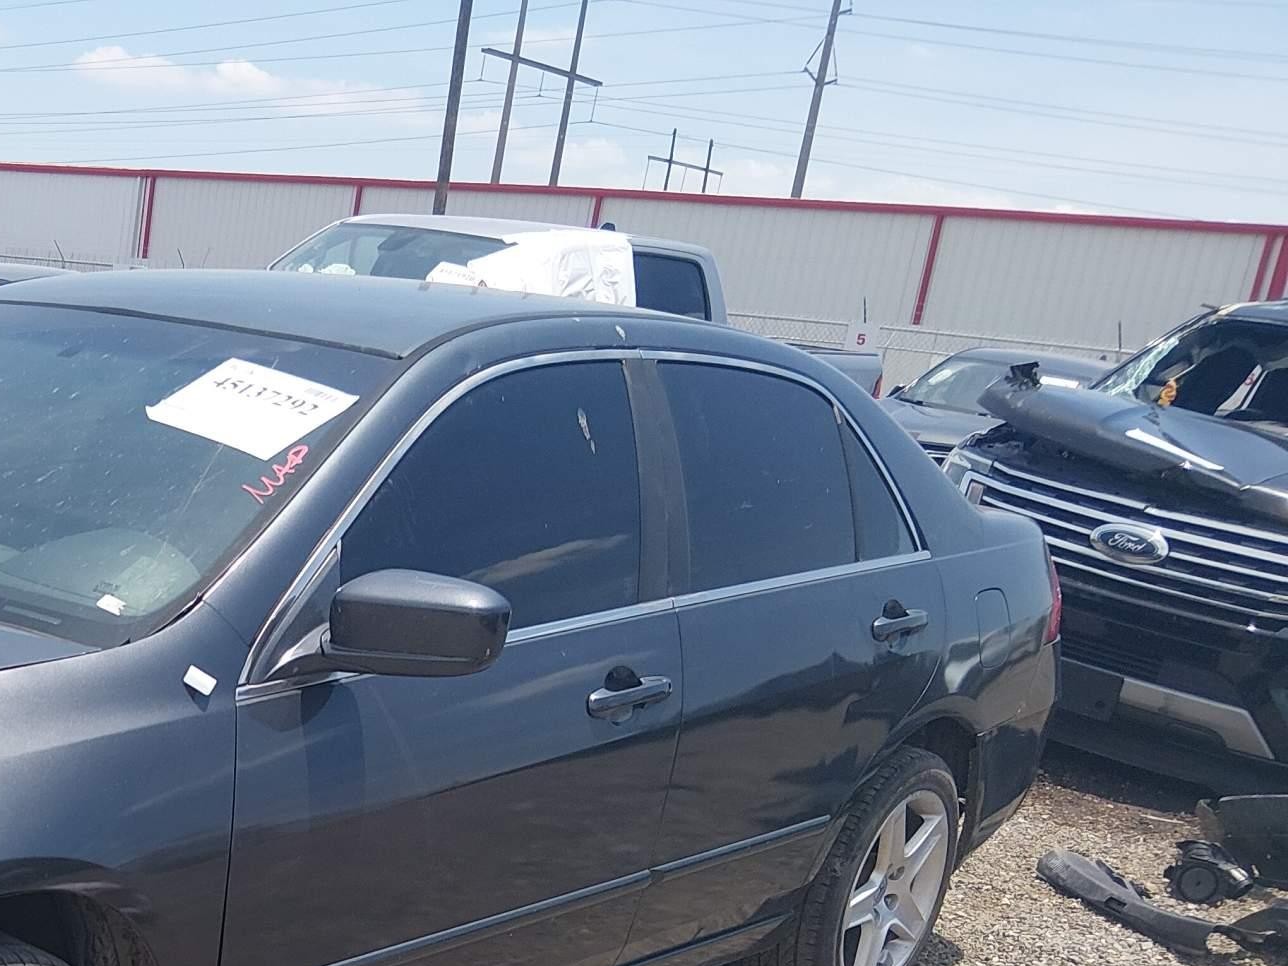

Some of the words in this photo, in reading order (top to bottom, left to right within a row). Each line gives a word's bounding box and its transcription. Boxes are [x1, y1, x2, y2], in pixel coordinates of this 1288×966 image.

[856, 333, 866, 346] 5
[213, 377, 319, 417] 45137292
[1107, 532, 1147, 552] Ford
